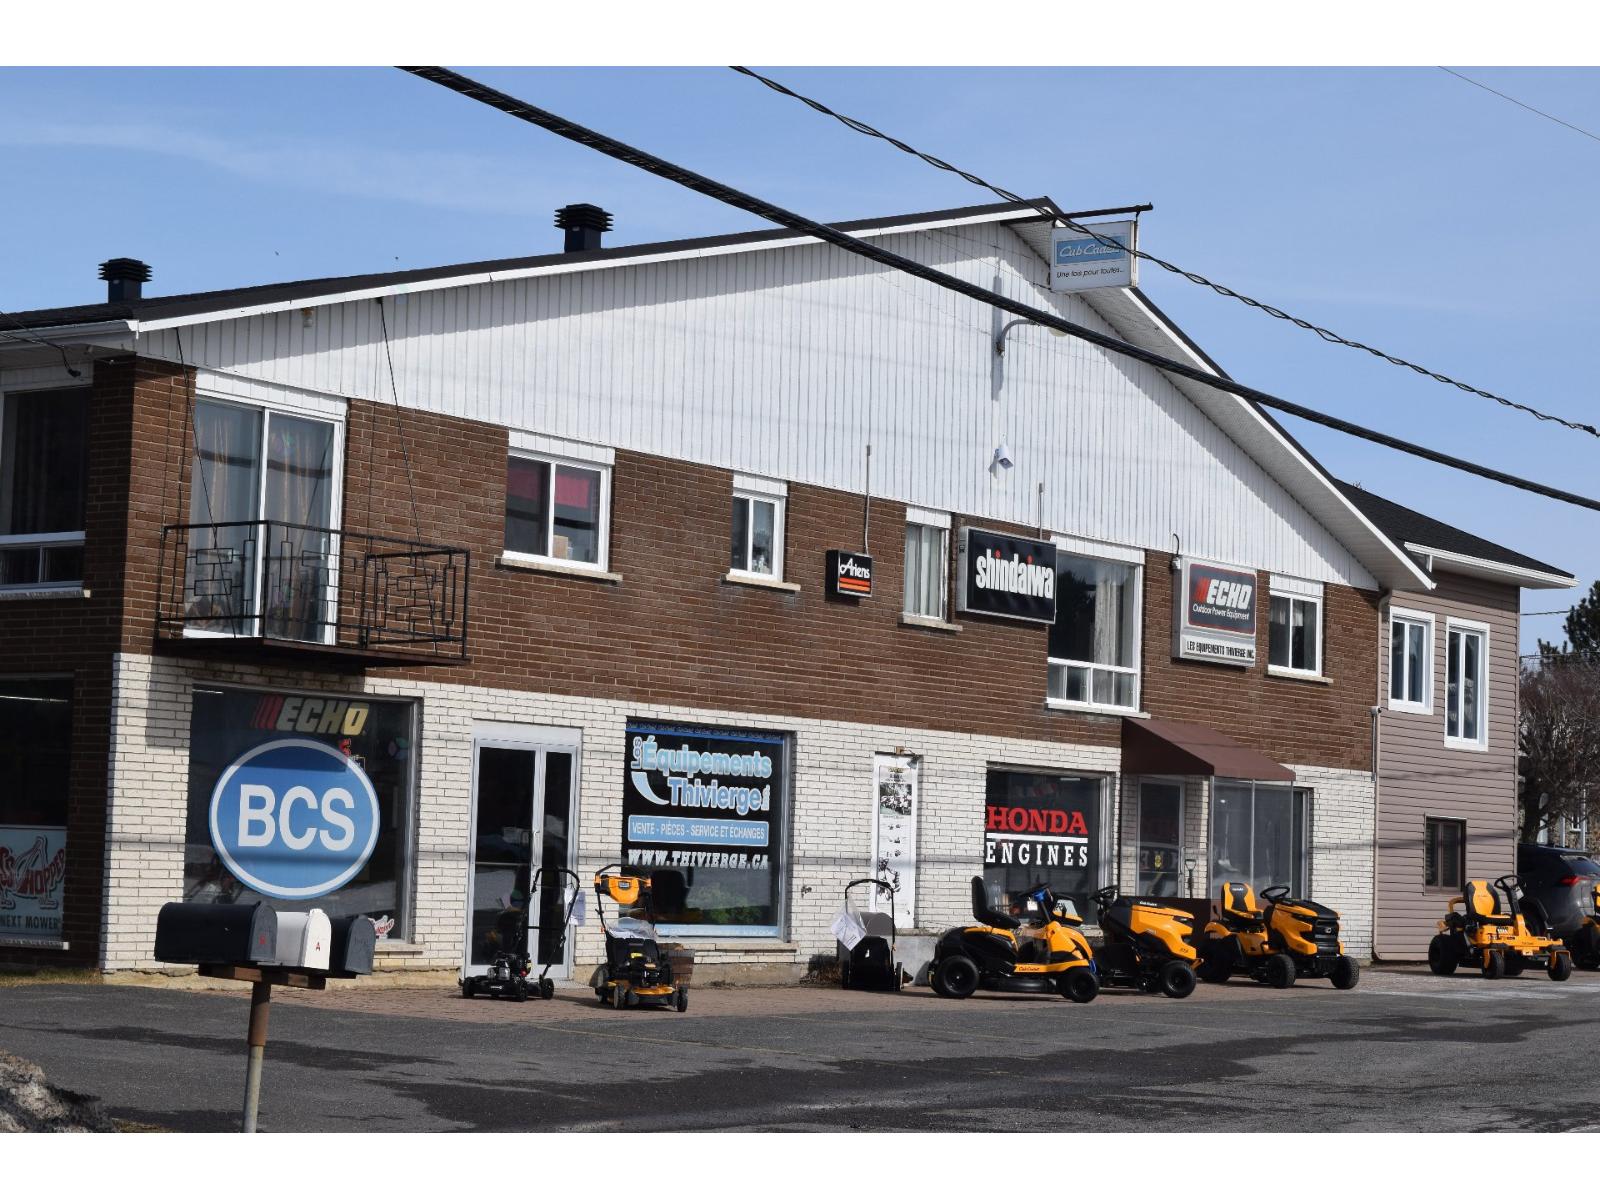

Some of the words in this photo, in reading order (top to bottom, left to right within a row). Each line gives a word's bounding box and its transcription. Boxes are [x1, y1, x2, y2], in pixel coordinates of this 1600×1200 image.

[1060, 245, 1082, 257] Cub
[1083, 269, 1099, 278] pour
[839, 557, 870, 579] Ariens
[975, 548, 1054, 599] shindaiwa
[1207, 579, 1252, 609] ECHO
[1192, 603, 1212, 614] Outdoor
[1212, 606, 1226, 616] Power
[1226, 608, 1250, 621] Equipment
[1186, 640, 1196, 651] LES
[276, 696, 369, 736] ECHO
[631, 735, 643, 770] Les
[642, 735, 772, 778] Équipements
[667, 776, 763, 816] Thivierge
[237, 783, 355, 852] BCS
[985, 805, 1088, 835] HONDA
[632, 822, 655, 836] VENTE
[690, 825, 719, 838] SERVICE
[720, 826, 729, 838] ET
[729, 824, 765, 840] ÉCHANGES
[627, 849, 769, 870] WWW.THIVIERGE.CA
[985, 841, 1088, 867] ENGINES
[0, 914, 22, 929] NEXT
[315, 941, 321, 952] A
